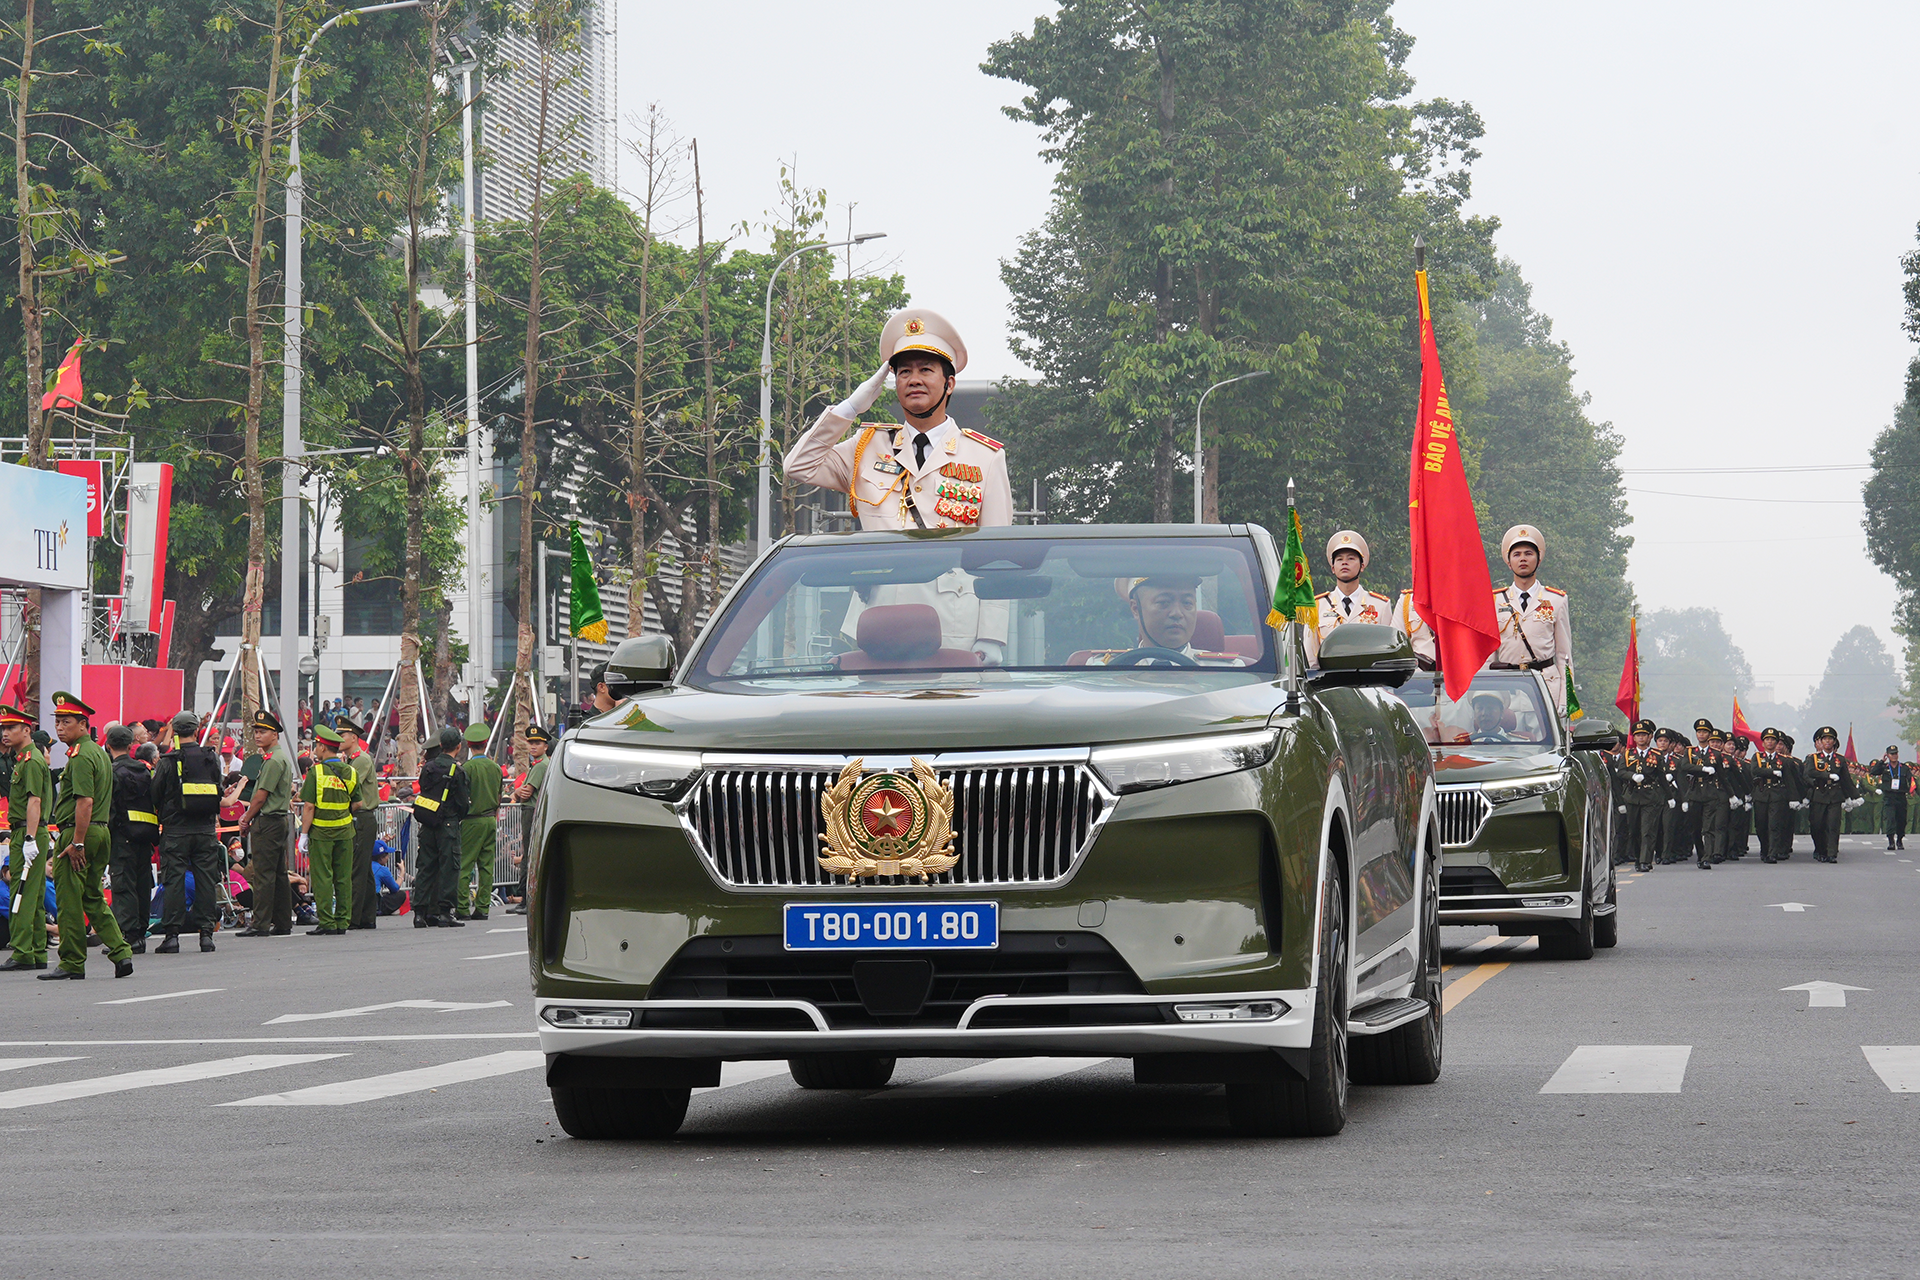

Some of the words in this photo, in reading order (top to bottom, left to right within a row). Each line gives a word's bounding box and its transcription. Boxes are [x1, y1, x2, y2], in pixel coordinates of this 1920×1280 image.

[1429, 420, 1455, 439] VỆ
[33, 528, 58, 571] TH
[803, 911, 979, 941] T80-001.80
